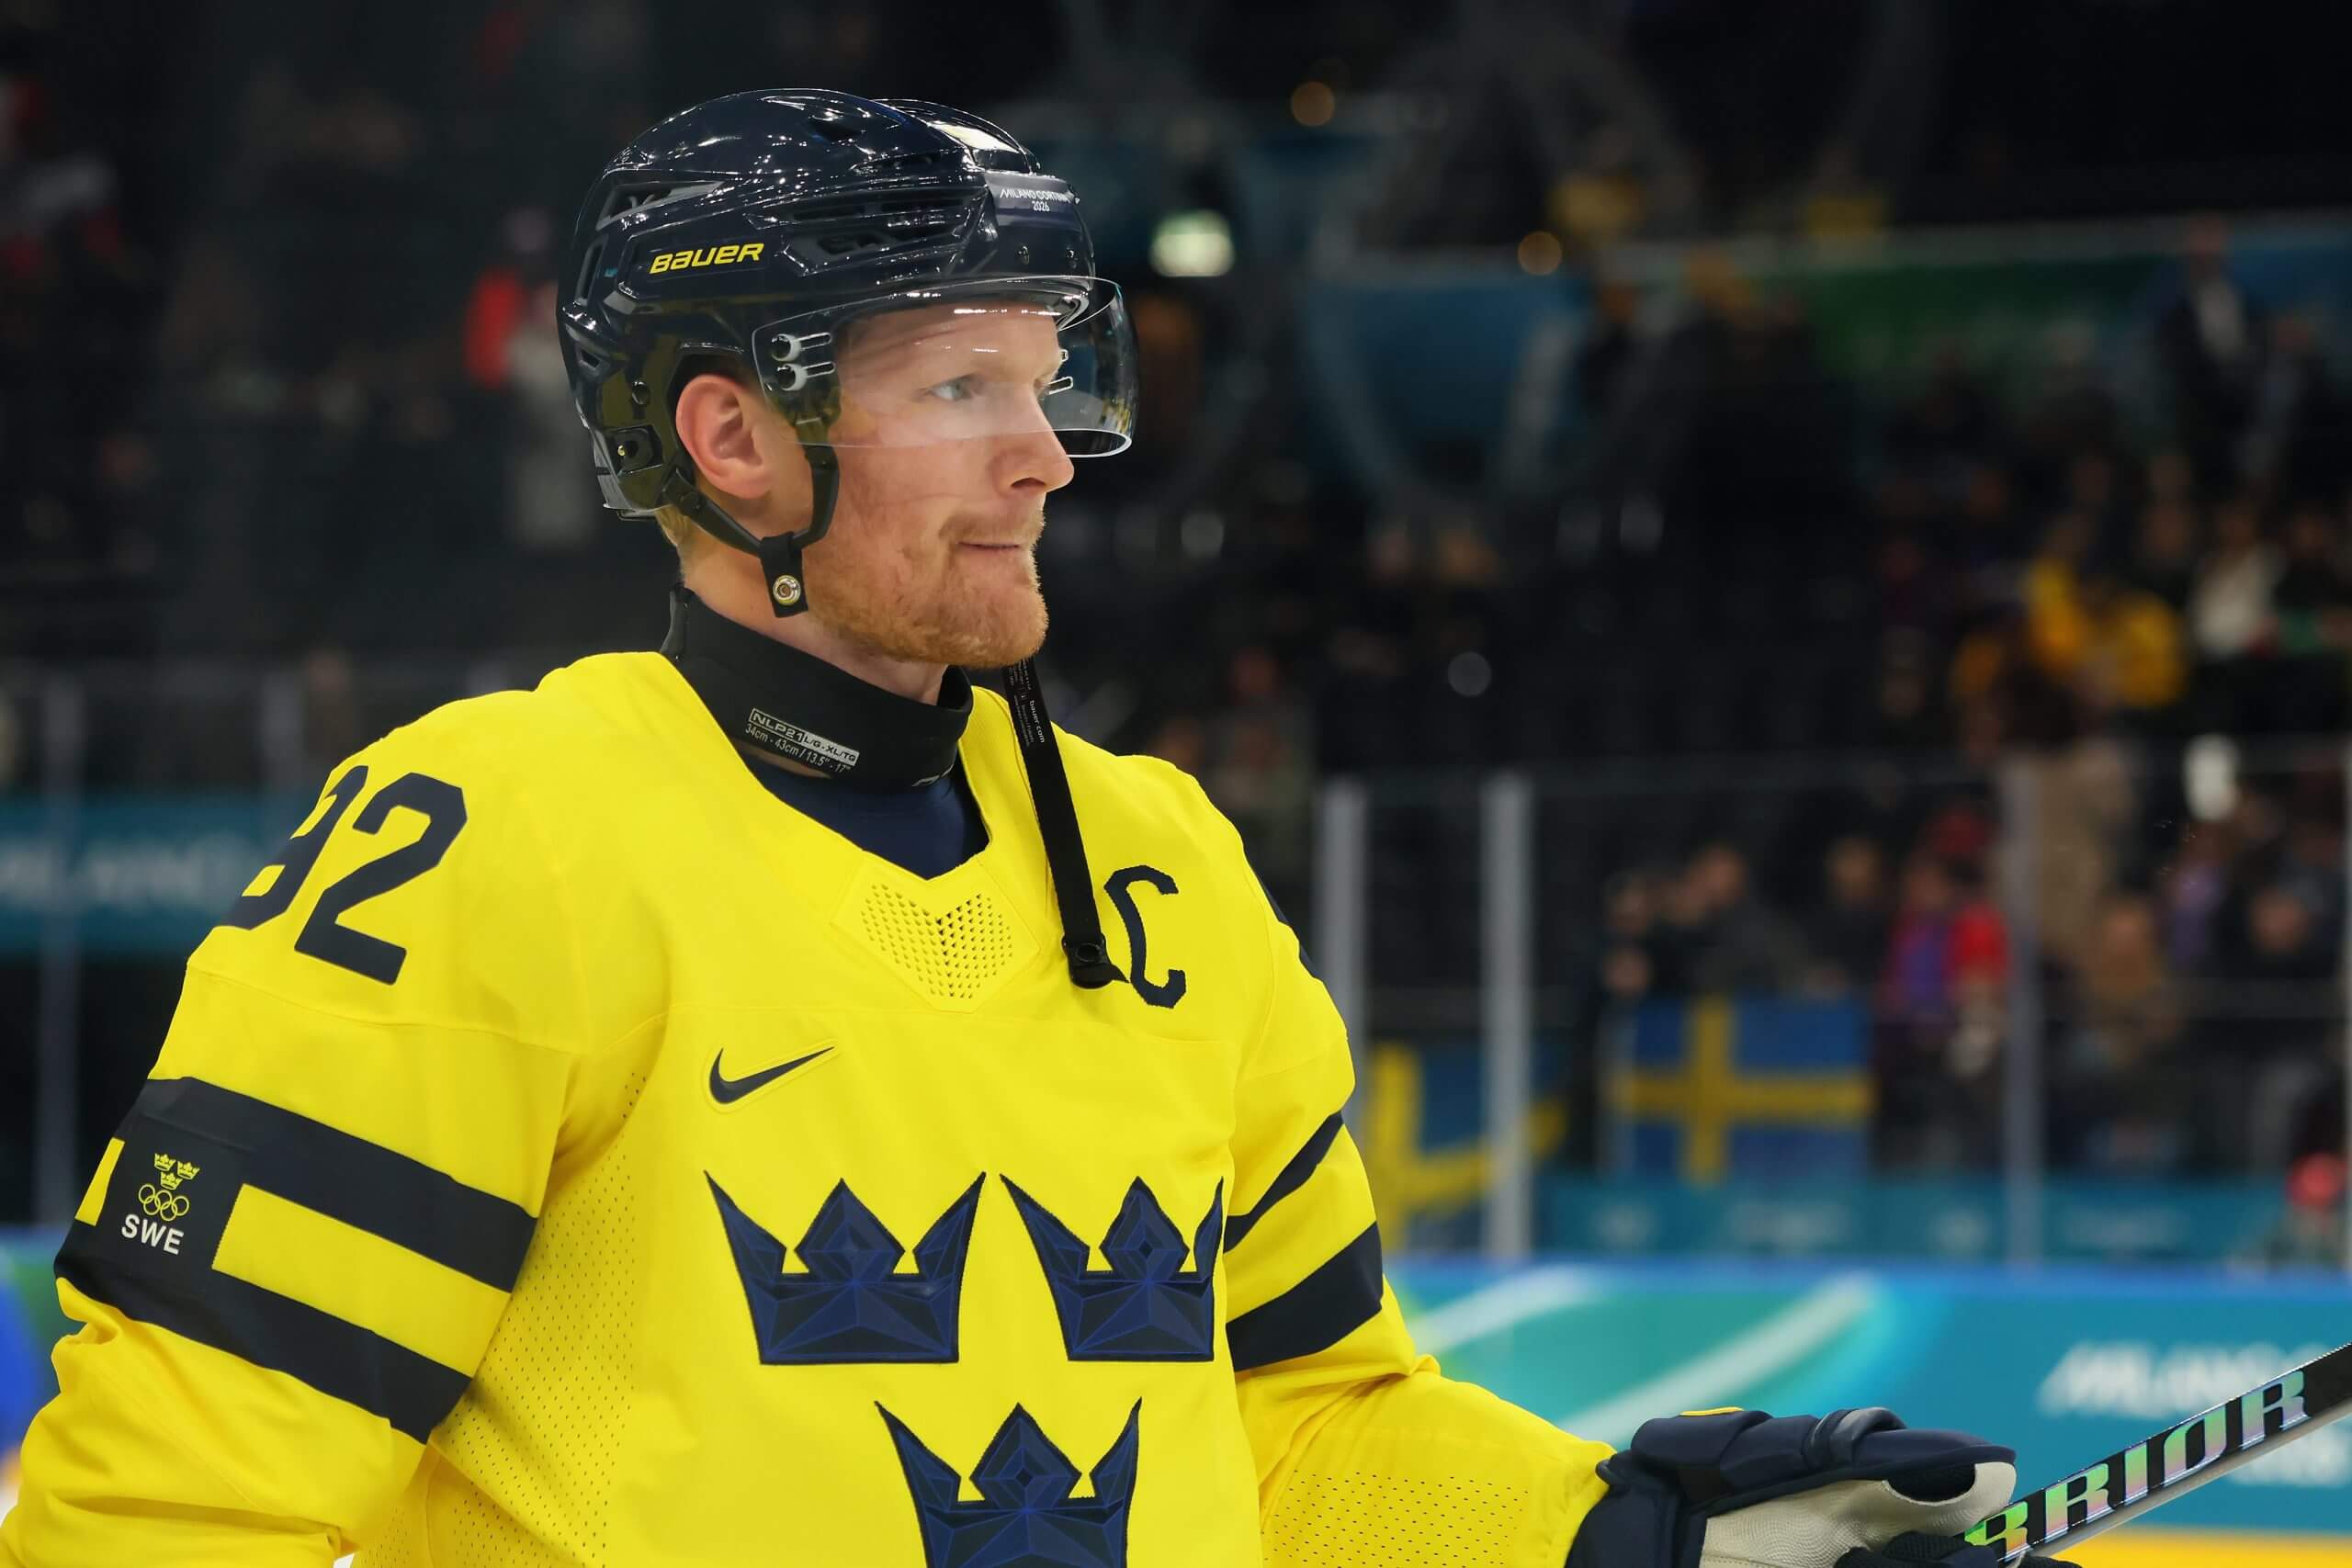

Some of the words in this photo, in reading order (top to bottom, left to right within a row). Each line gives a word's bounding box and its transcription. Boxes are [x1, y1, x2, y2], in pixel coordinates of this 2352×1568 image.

[1031, 200, 1050, 212] 2026
[745, 723, 769, 744] 34cm
[775, 738, 799, 756] 43cm
[752, 712, 803, 743] NLP21
[1027, 699, 1046, 744] bauercom
[216, 763, 468, 986] 92
[1103, 864, 1187, 1010] C
[120, 1213, 186, 1256] SWE
[1963, 1369, 2312, 1563] RRIOR
